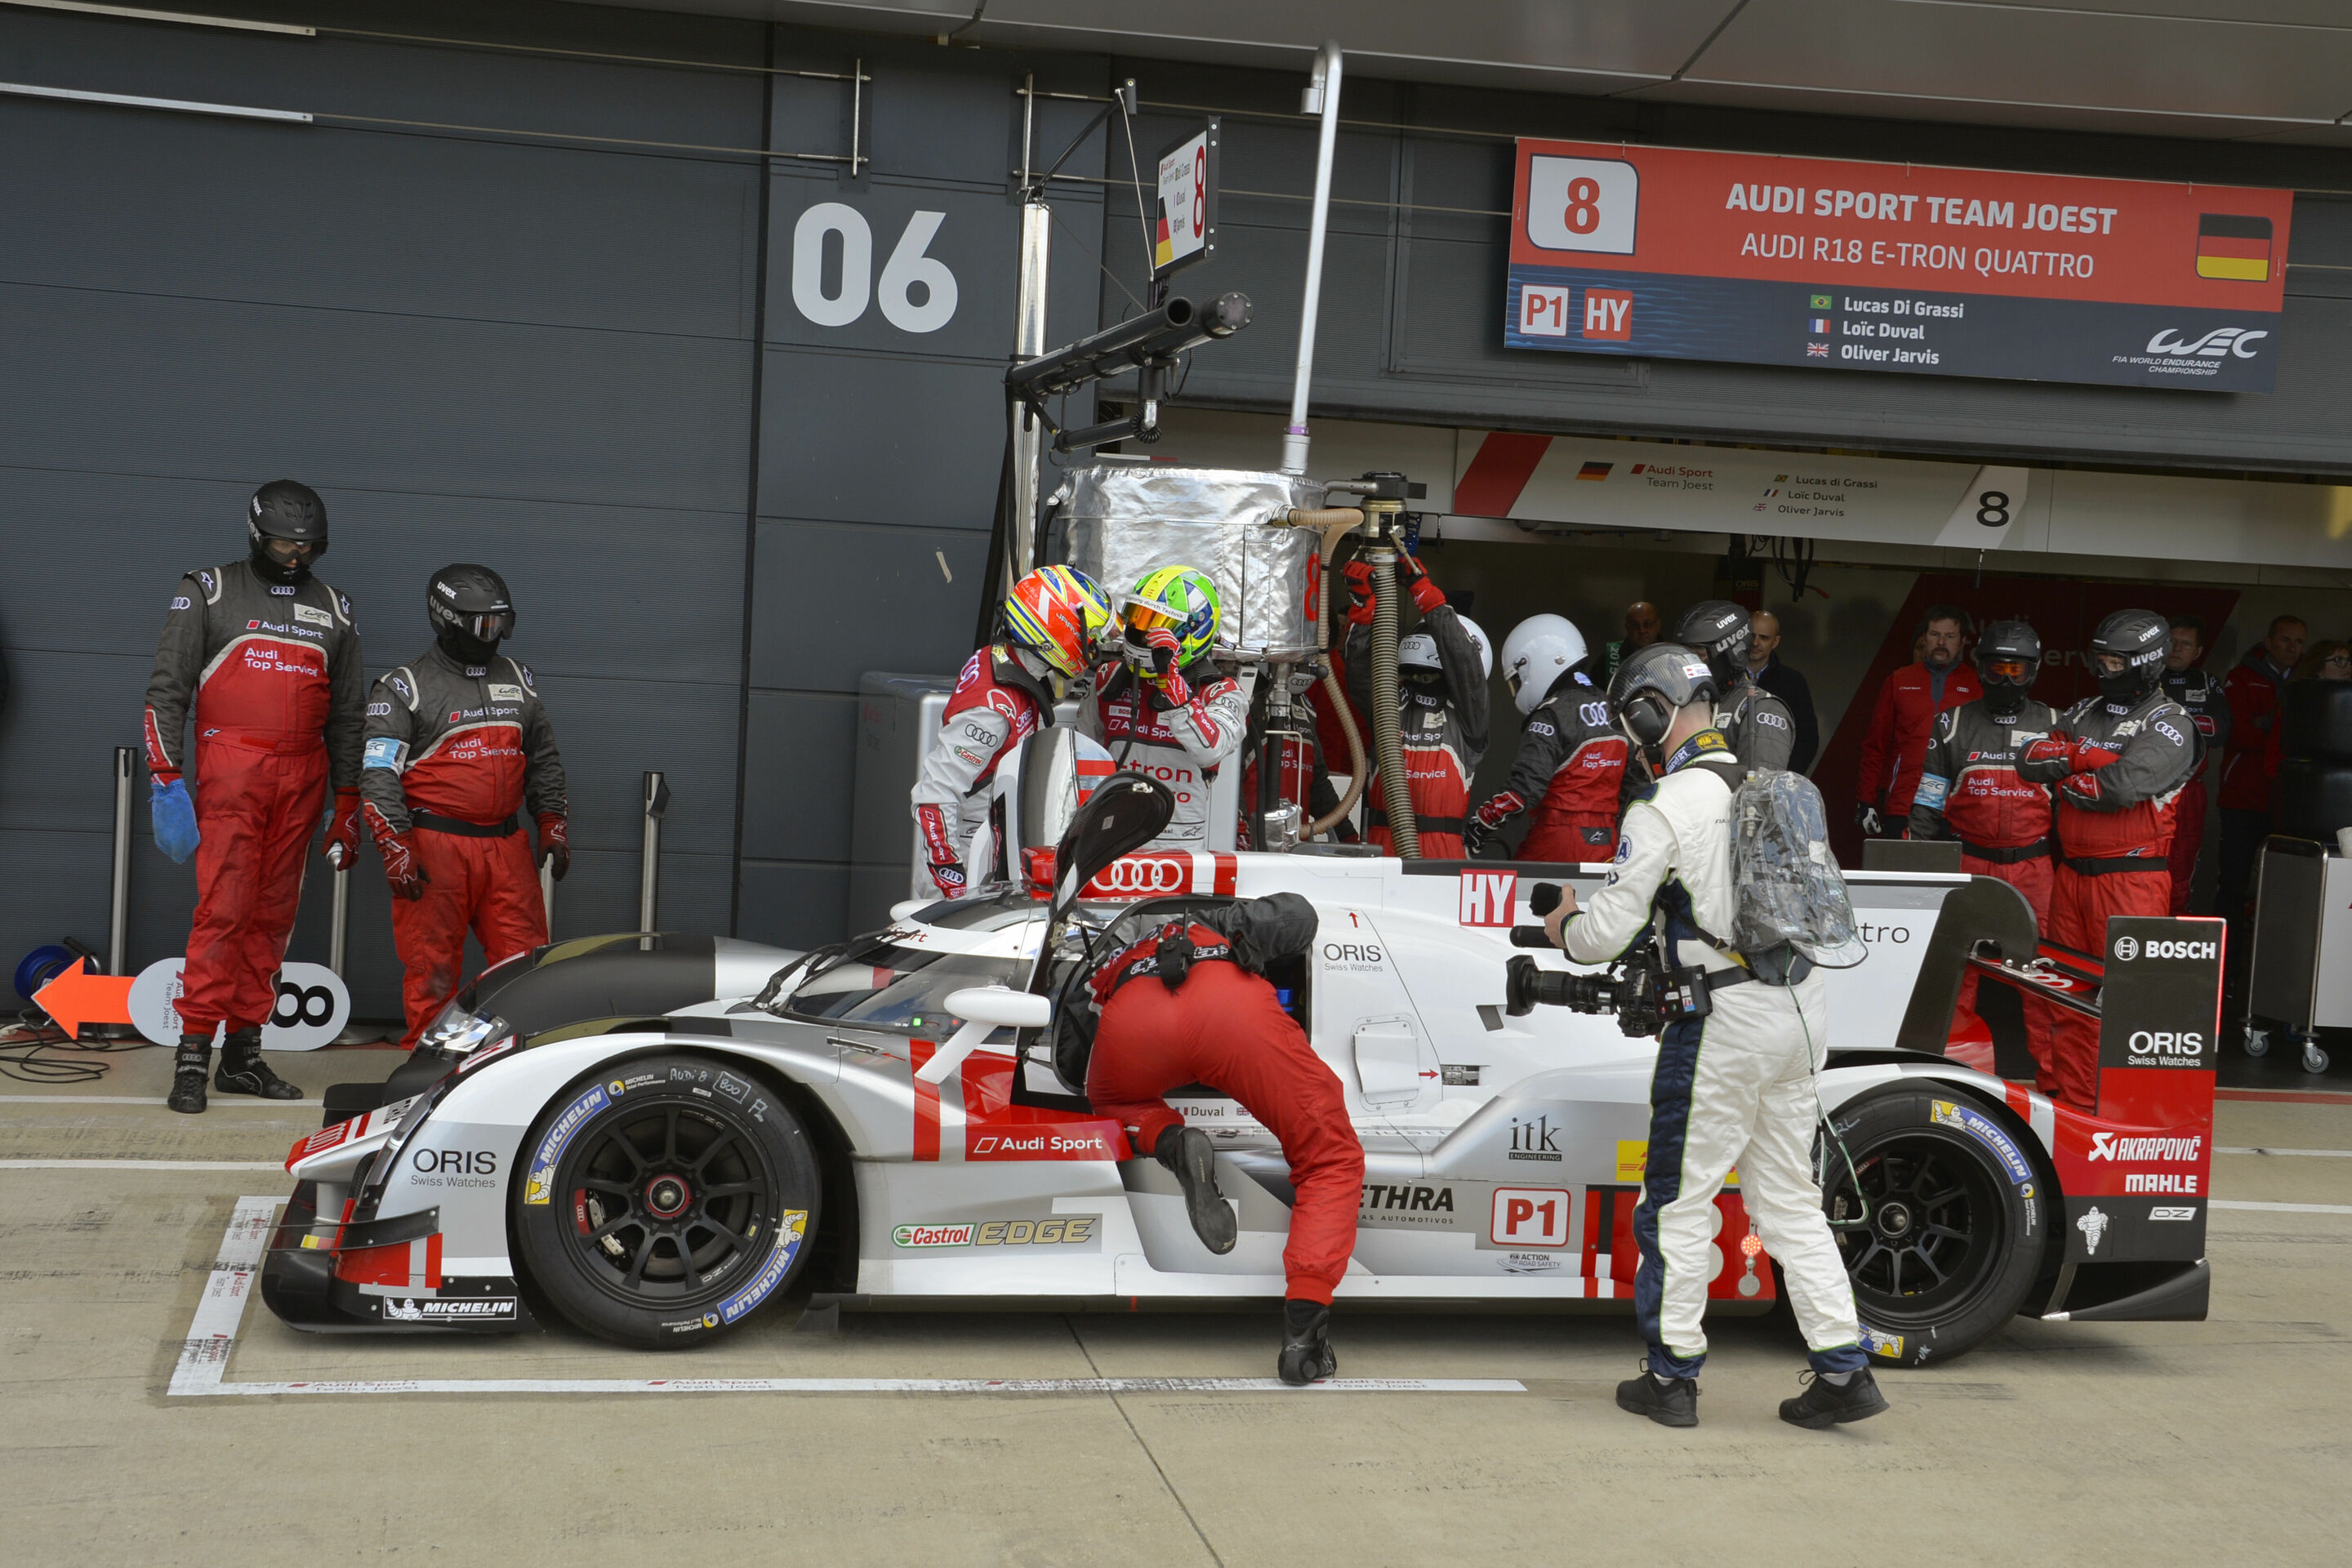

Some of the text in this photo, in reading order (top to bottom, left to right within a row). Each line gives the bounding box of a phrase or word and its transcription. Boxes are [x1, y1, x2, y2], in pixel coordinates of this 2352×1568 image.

[1194, 145, 1205, 238] 8
[1564, 177, 1600, 234] 8
[1726, 184, 2118, 234] AUDI SPORT TEAM JOEST
[1740, 233, 2095, 278] AUDI R18 E-TRON QUATTRO
[792, 203, 958, 333] 06
[1526, 294, 1563, 327] P1
[1587, 297, 1629, 332] HY
[1844, 297, 1964, 318] Lucas Di Grassi
[1842, 321, 1925, 340] Loïc Duval
[2146, 327, 2269, 359] WEC
[1841, 345, 1940, 365] Oliver Jarvis
[2130, 357, 2162, 365] WORLD
[2163, 359, 2221, 368] ENDURANCE
[2149, 366, 2218, 376] CHAMPIONSHIP
[1646, 465, 1713, 478] Audi Sport
[1646, 477, 1713, 490] Team Joest
[1796, 476, 1878, 488] Lucas di Grassi
[1788, 491, 1845, 501] Loïc Duval
[1778, 505, 1844, 516] Oliver Jarvis
[1976, 491, 2010, 528] 8
[437, 581, 456, 599] uvex
[1304, 553, 1321, 622] 8
[430, 595, 465, 627] uvex
[1144, 599, 1161, 610] durch
[1162, 605, 1183, 619] Technik
[262, 621, 323, 639] Audi Sport
[1717, 613, 1738, 629] uvex
[1716, 623, 1750, 652] uvex
[2139, 626, 2160, 642] uvex
[245, 647, 278, 659] Audi
[2132, 647, 2164, 666] uvex
[245, 658, 271, 670] Top
[463, 706, 519, 719] Audi Sport
[1016, 706, 1032, 728] ORIS
[1121, 720, 1174, 738] Adi Spo
[450, 738, 482, 750] Audi
[450, 750, 476, 760] Top
[960, 751, 982, 764] Castrol
[1582, 760, 1597, 768] Top
[1981, 751, 2006, 760] Audi
[1122, 759, 1192, 782] -tron
[1405, 770, 1446, 779] Service
[1968, 786, 2033, 797] Top Service
[929, 822, 938, 840] Audi
[1618, 842, 1628, 858] A
[1461, 874, 1514, 924] HY
[1324, 943, 1381, 962] ORIS
[2145, 941, 2216, 959] BOSCH
[1325, 963, 1383, 973] Swiss Watches
[270, 982, 334, 1027] 8
[2129, 1031, 2203, 1055] ORIS
[2128, 1056, 2201, 1067] Swiss Watches
[626, 1074, 654, 1085] MICHELIN
[637, 1079, 666, 1089] Performance
[1191, 1107, 1224, 1116] Duval
[540, 1090, 602, 1163] MICHELIN
[1509, 1115, 1561, 1152] itk
[1000, 1137, 1102, 1152] Audi Sport
[1967, 1116, 2027, 1178] MICHELIN
[2117, 1136, 2202, 1161] AKRAPOVIČ
[412, 1148, 497, 1174] ORIS
[1510, 1153, 1561, 1161] ENGINEERING
[411, 1175, 496, 1187] Swiss Watches
[2125, 1174, 2198, 1193] MAHLE
[1359, 1184, 1454, 1212] ETHRA
[1381, 1215, 1454, 1224] AUTOMOTIVOS
[1506, 1198, 1556, 1236] P1
[2029, 1199, 2037, 1225] MICHELIN
[912, 1218, 1097, 1246] Castrol EDGE
[727, 1250, 790, 1319] MICHELIN
[422, 1302, 514, 1312] MICHELIN
[673, 1323, 702, 1332] MICHELIN
